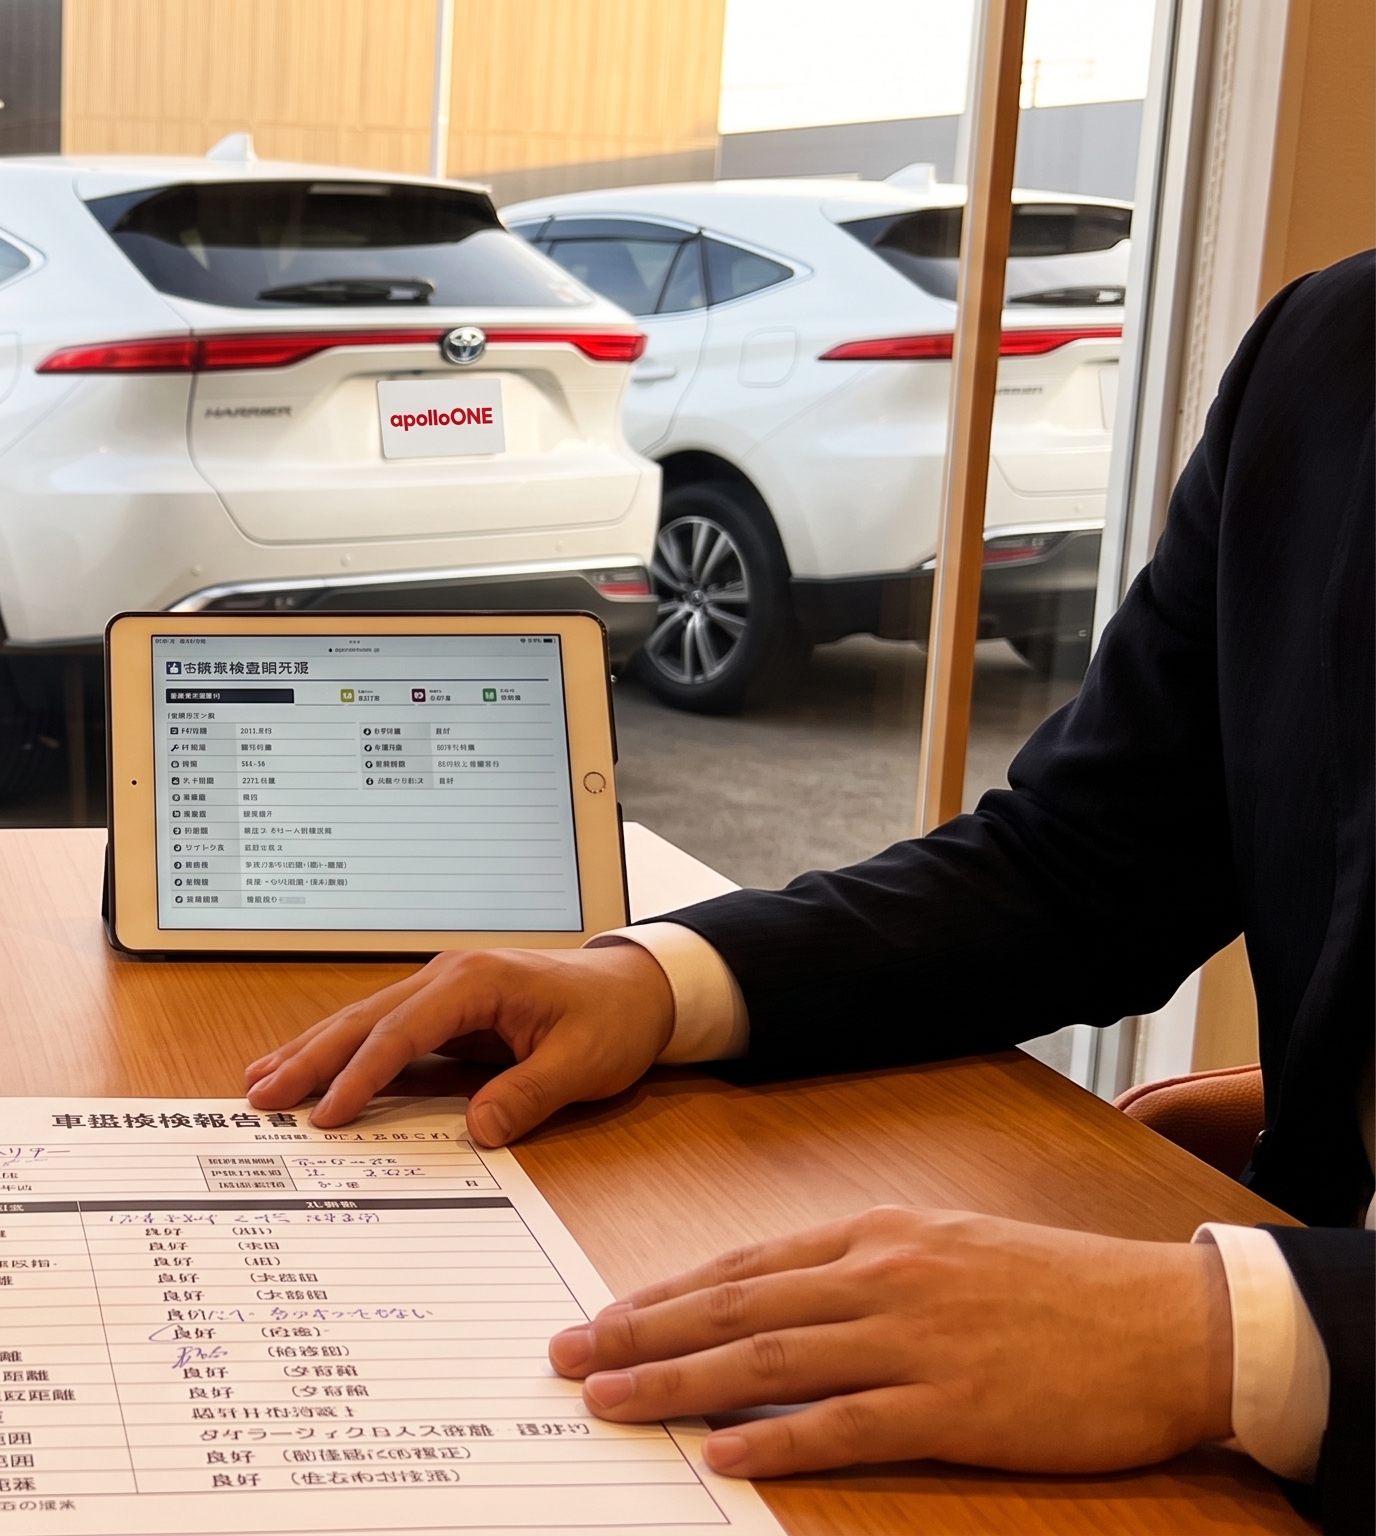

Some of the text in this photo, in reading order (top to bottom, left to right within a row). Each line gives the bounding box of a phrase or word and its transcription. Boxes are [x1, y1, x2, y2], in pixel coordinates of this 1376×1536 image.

[390, 407, 493, 431] apolloONE
[188, 1386, 235, 1400] 良好
[206, 1449, 256, 1465] 良好
[211, 1472, 262, 1488] 良好
